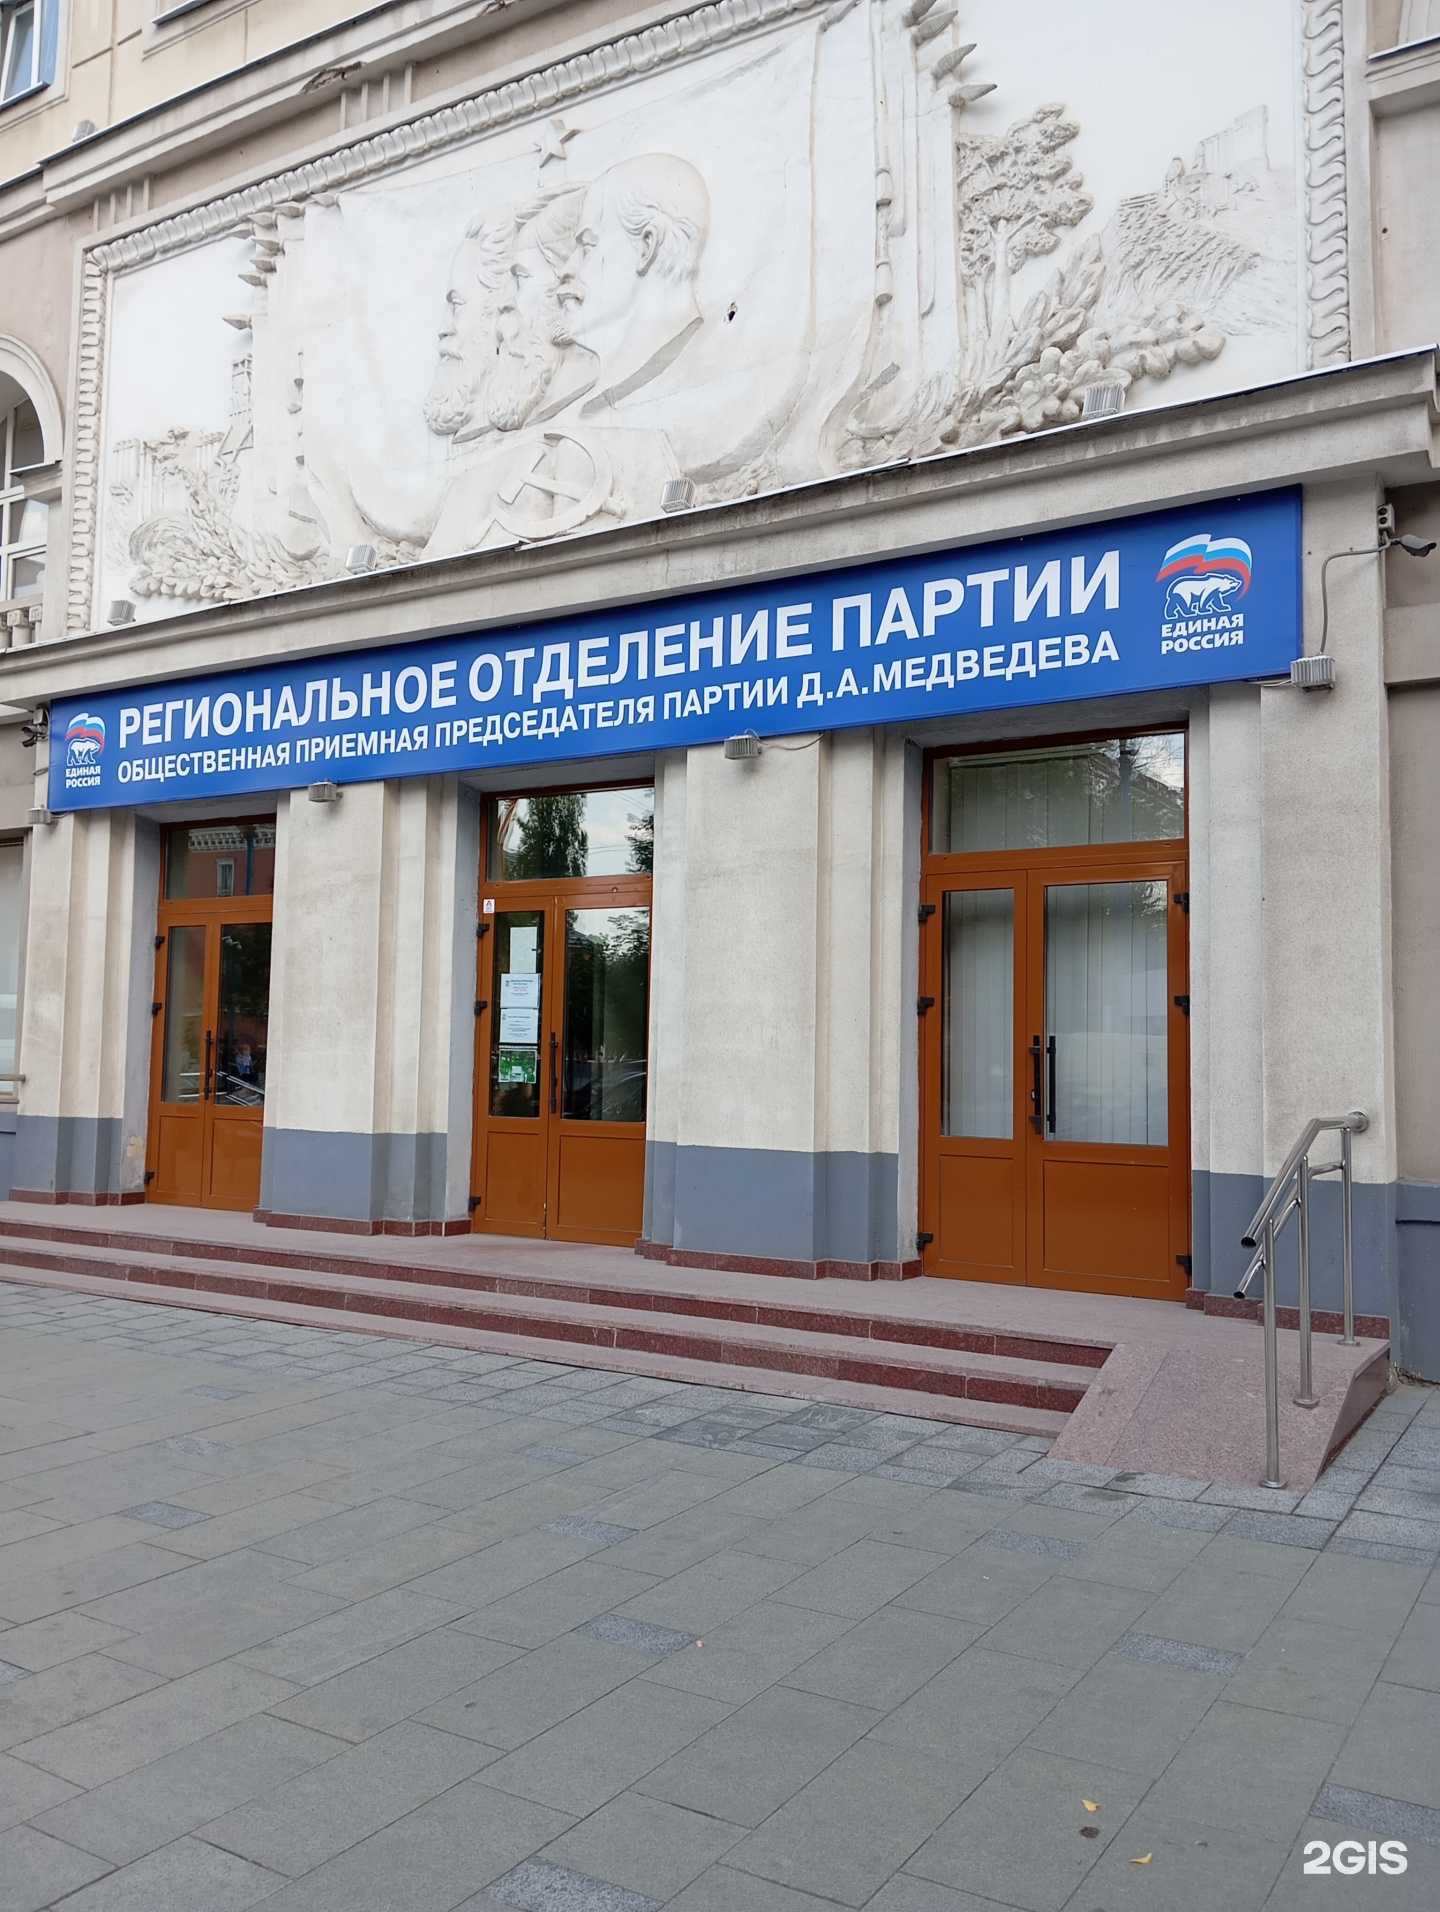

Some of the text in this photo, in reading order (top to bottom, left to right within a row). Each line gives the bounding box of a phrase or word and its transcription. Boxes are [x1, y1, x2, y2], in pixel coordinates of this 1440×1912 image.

[1160, 613, 1244, 638] ЕДИНАЯ
[118, 550, 1120, 748] РЕГИОНАЛЬНОЕ ОТДЕЛЕНИЕ ПАРТИИ
[1160, 630, 1244, 655] РОССИЯ
[117, 746, 290, 784] ОБЩЕСТВЕННАЯ
[295, 725, 428, 764] ПРИЕМНАЯ
[435, 696, 655, 747] ПРЕДСЕДАТЕЛЯ
[663, 676, 788, 719] ПАРТИИ
[65, 766, 101, 778] ЕДИНАЯ
[65, 776, 101, 789] РОССИЯ
